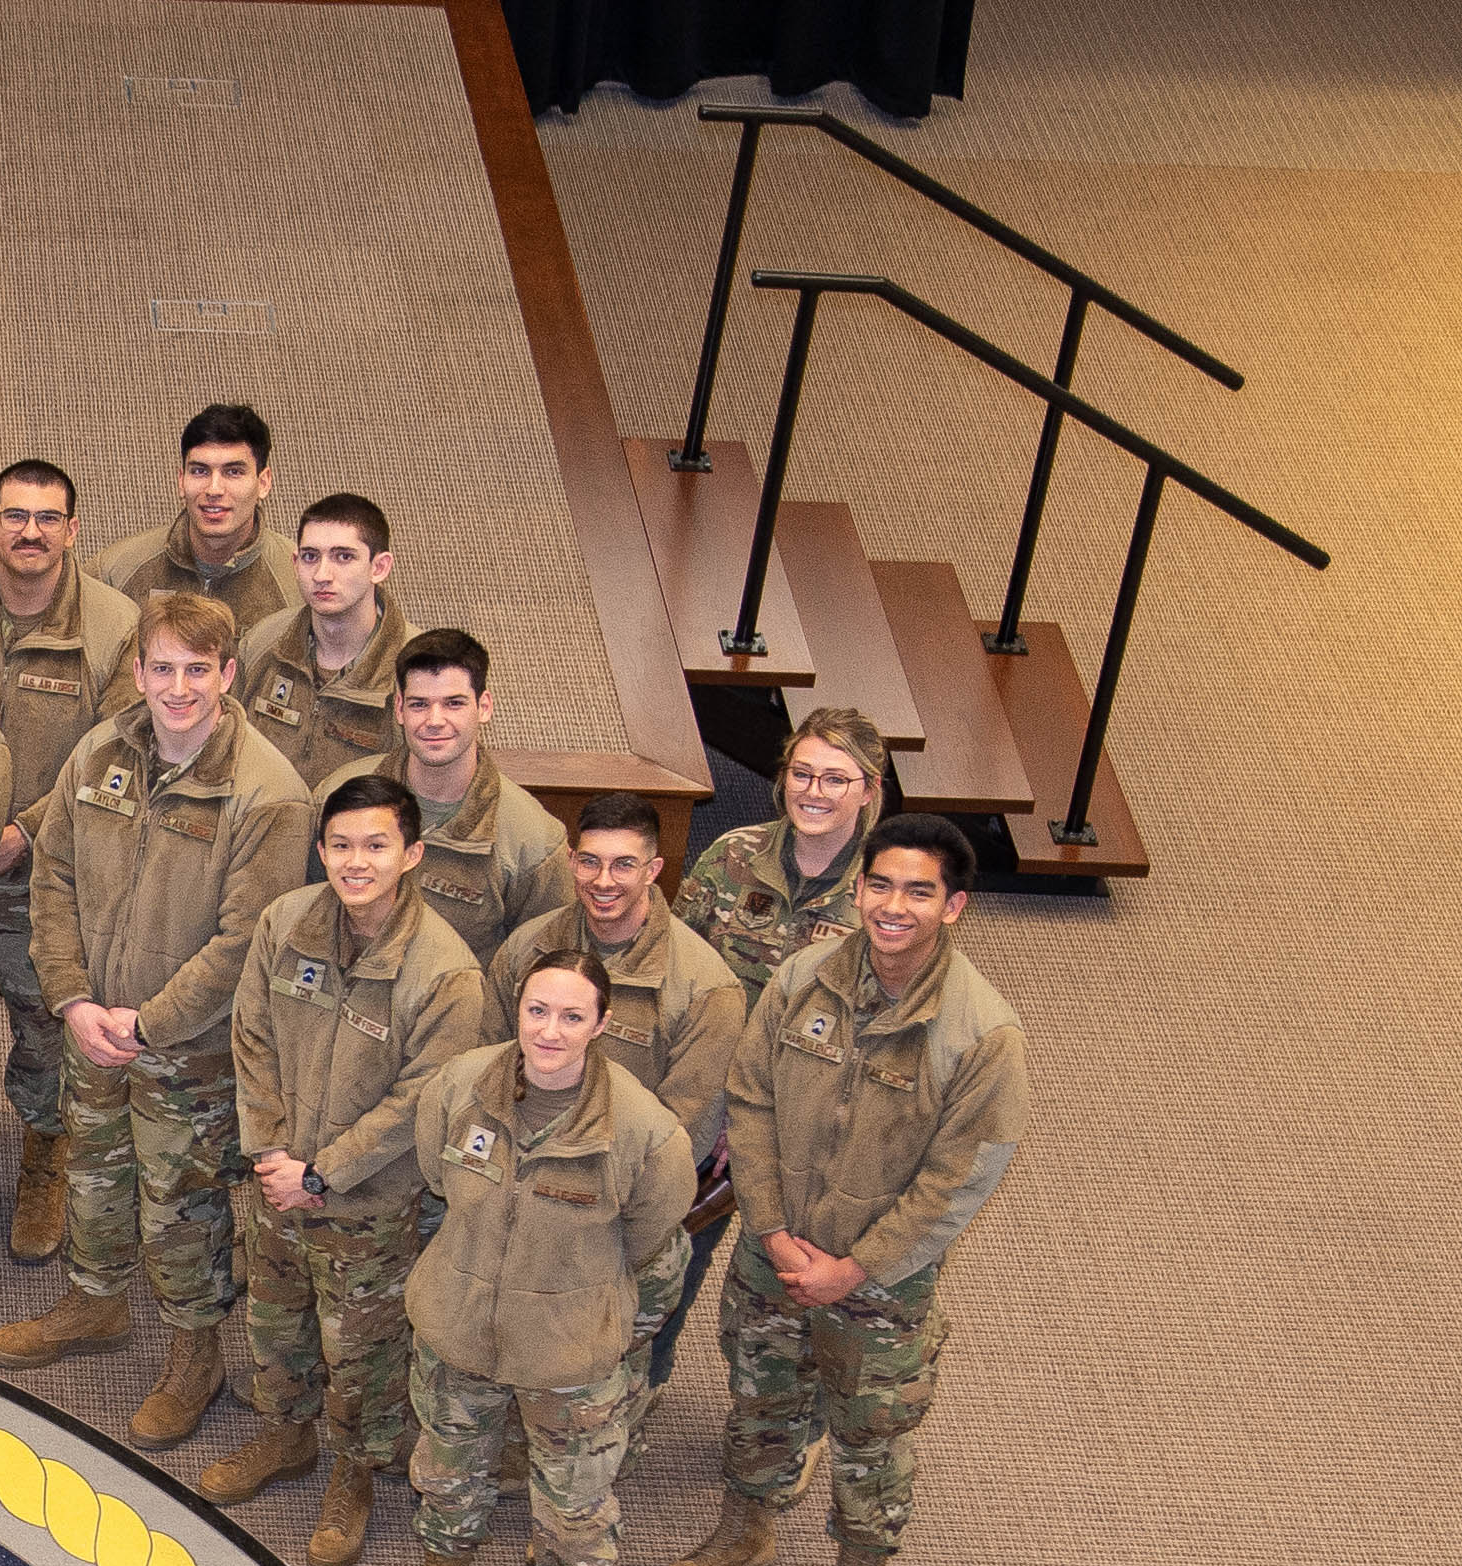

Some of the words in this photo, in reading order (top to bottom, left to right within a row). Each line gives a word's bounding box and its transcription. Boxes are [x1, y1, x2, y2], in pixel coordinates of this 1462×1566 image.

[22, 676, 36, 687] U.S.
[38, 678, 53, 689] AIR
[53, 680, 79, 693] FORCE
[92, 791, 121, 808] TAYLOR
